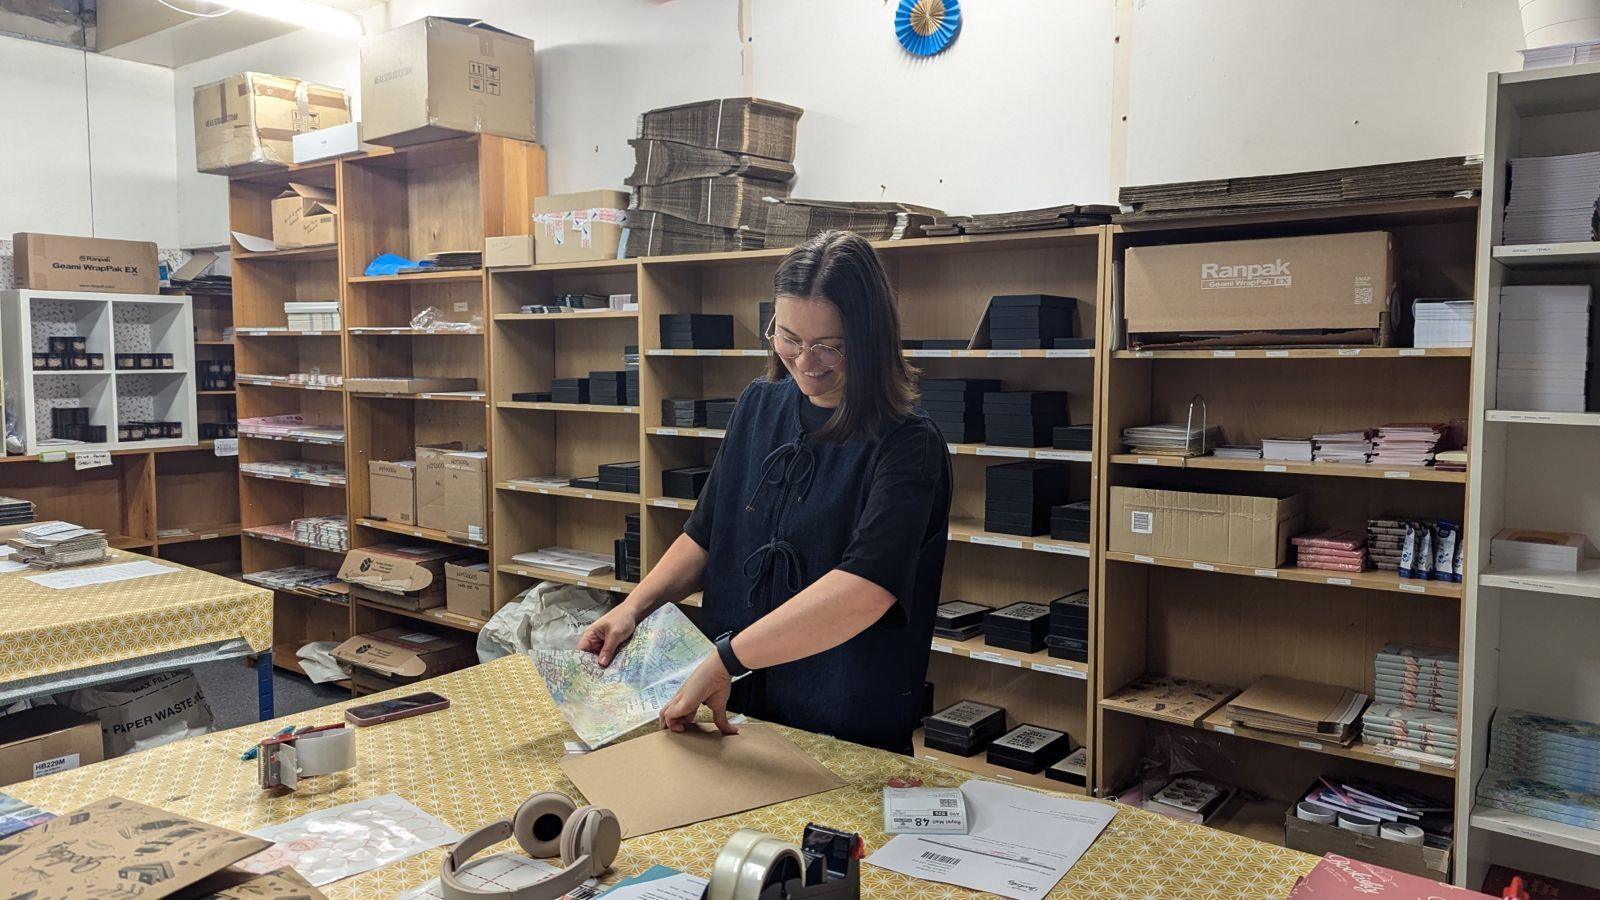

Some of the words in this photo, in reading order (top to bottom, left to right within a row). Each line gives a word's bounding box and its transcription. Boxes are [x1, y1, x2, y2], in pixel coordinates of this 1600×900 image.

[52, 262, 81, 270] Geami
[83, 264, 123, 273] WrapPak
[125, 266, 138, 274] EX
[1201, 258, 1291, 280] Ranpak
[152, 674, 170, 685] FILL
[113, 715, 153, 735] PAPER
[156, 698, 194, 721] WASTE
[35, 758, 66, 770] HB229M
[914, 817, 930, 827] 48
